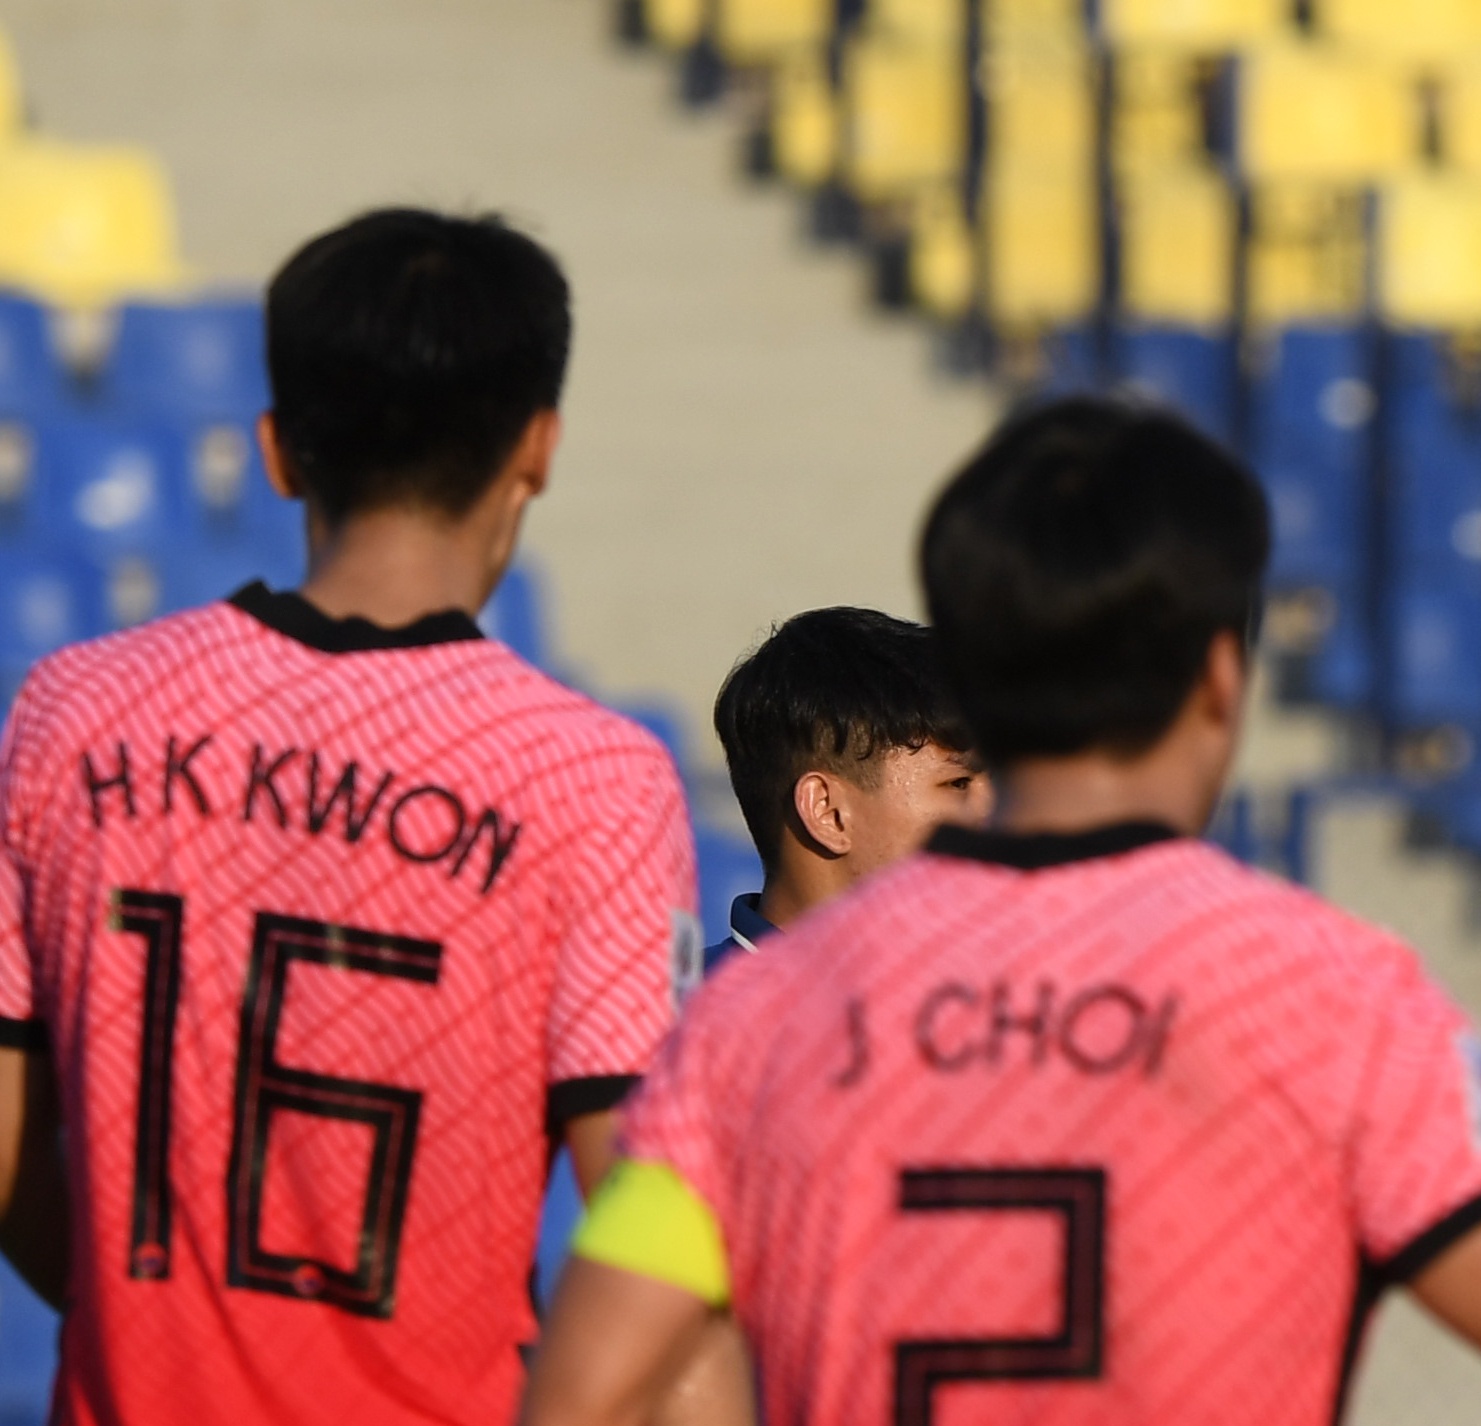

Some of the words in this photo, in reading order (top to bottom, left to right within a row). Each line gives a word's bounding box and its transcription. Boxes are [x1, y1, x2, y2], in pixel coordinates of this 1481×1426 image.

[243, 743, 522, 895] KWON
[109, 888, 445, 1320] 16
[913, 979, 1183, 1081] CHOI
